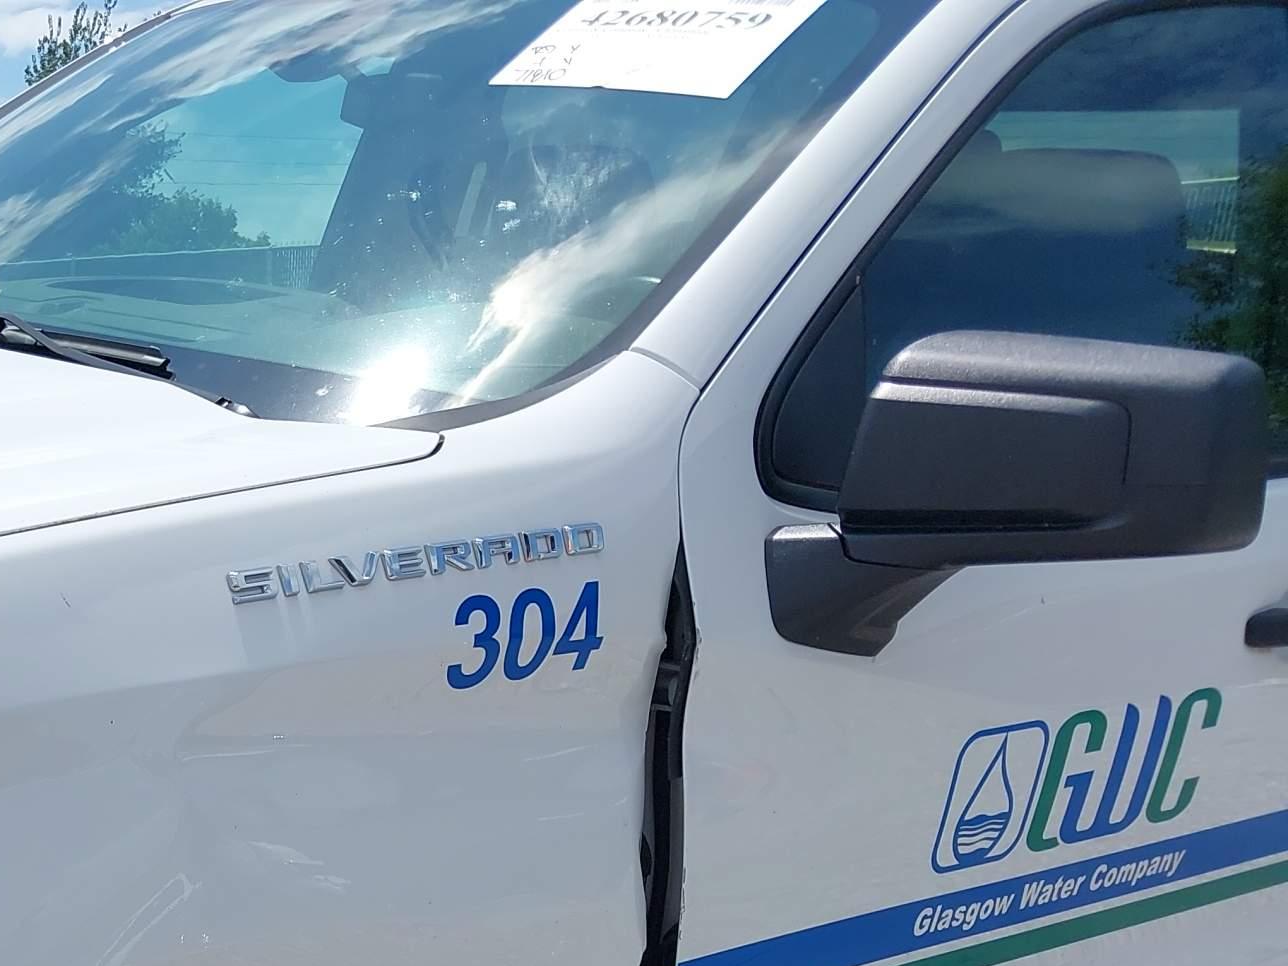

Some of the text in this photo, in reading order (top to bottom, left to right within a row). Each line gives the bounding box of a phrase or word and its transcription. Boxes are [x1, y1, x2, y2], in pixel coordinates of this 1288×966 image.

[580, 9, 773, 30] 42680759
[225, 522, 605, 605] SILVERADO
[446, 580, 604, 691] 304
[1026, 686, 1223, 853] GWC
[913, 849, 1186, 938] Glasgow Water Company
